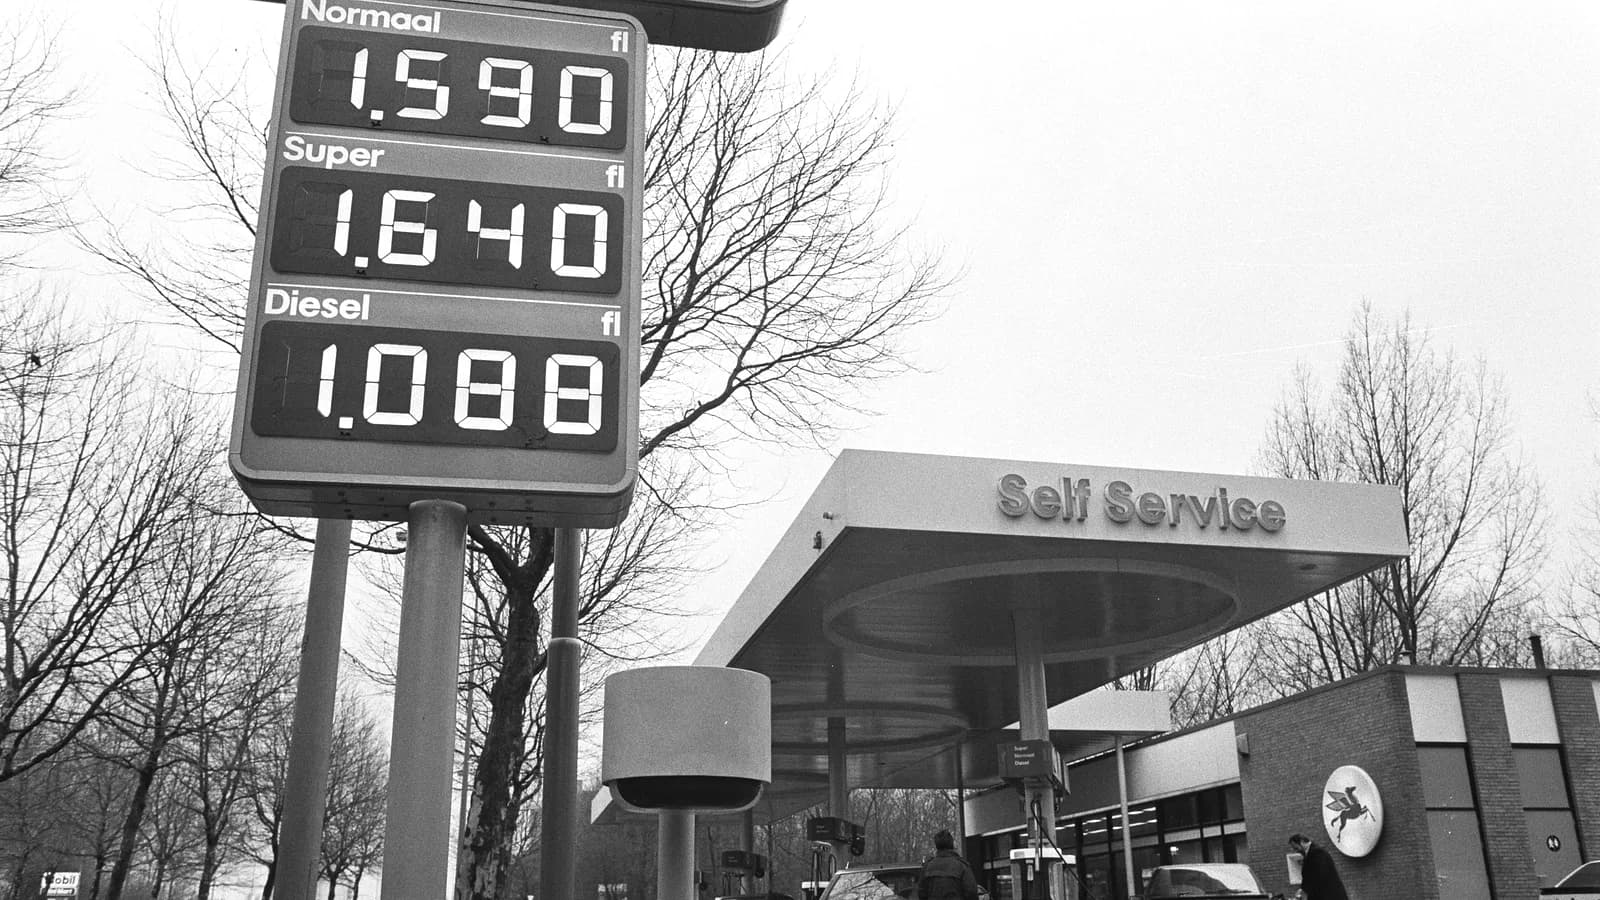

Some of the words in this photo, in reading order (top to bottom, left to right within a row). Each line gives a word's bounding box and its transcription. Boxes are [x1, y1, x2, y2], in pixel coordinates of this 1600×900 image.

[301, 0, 440, 33] Normaal
[611, 31, 629, 53] fl
[350, 47, 613, 135] 1.590
[283, 135, 385, 170] Super
[605, 164, 625, 188] fl
[334, 189, 608, 279] 1.640
[264, 289, 371, 321] Diesel
[601, 311, 621, 337] fl
[316, 344, 604, 435] 1.088
[997, 473, 1091, 521] Self
[1103, 480, 1287, 533] Service
